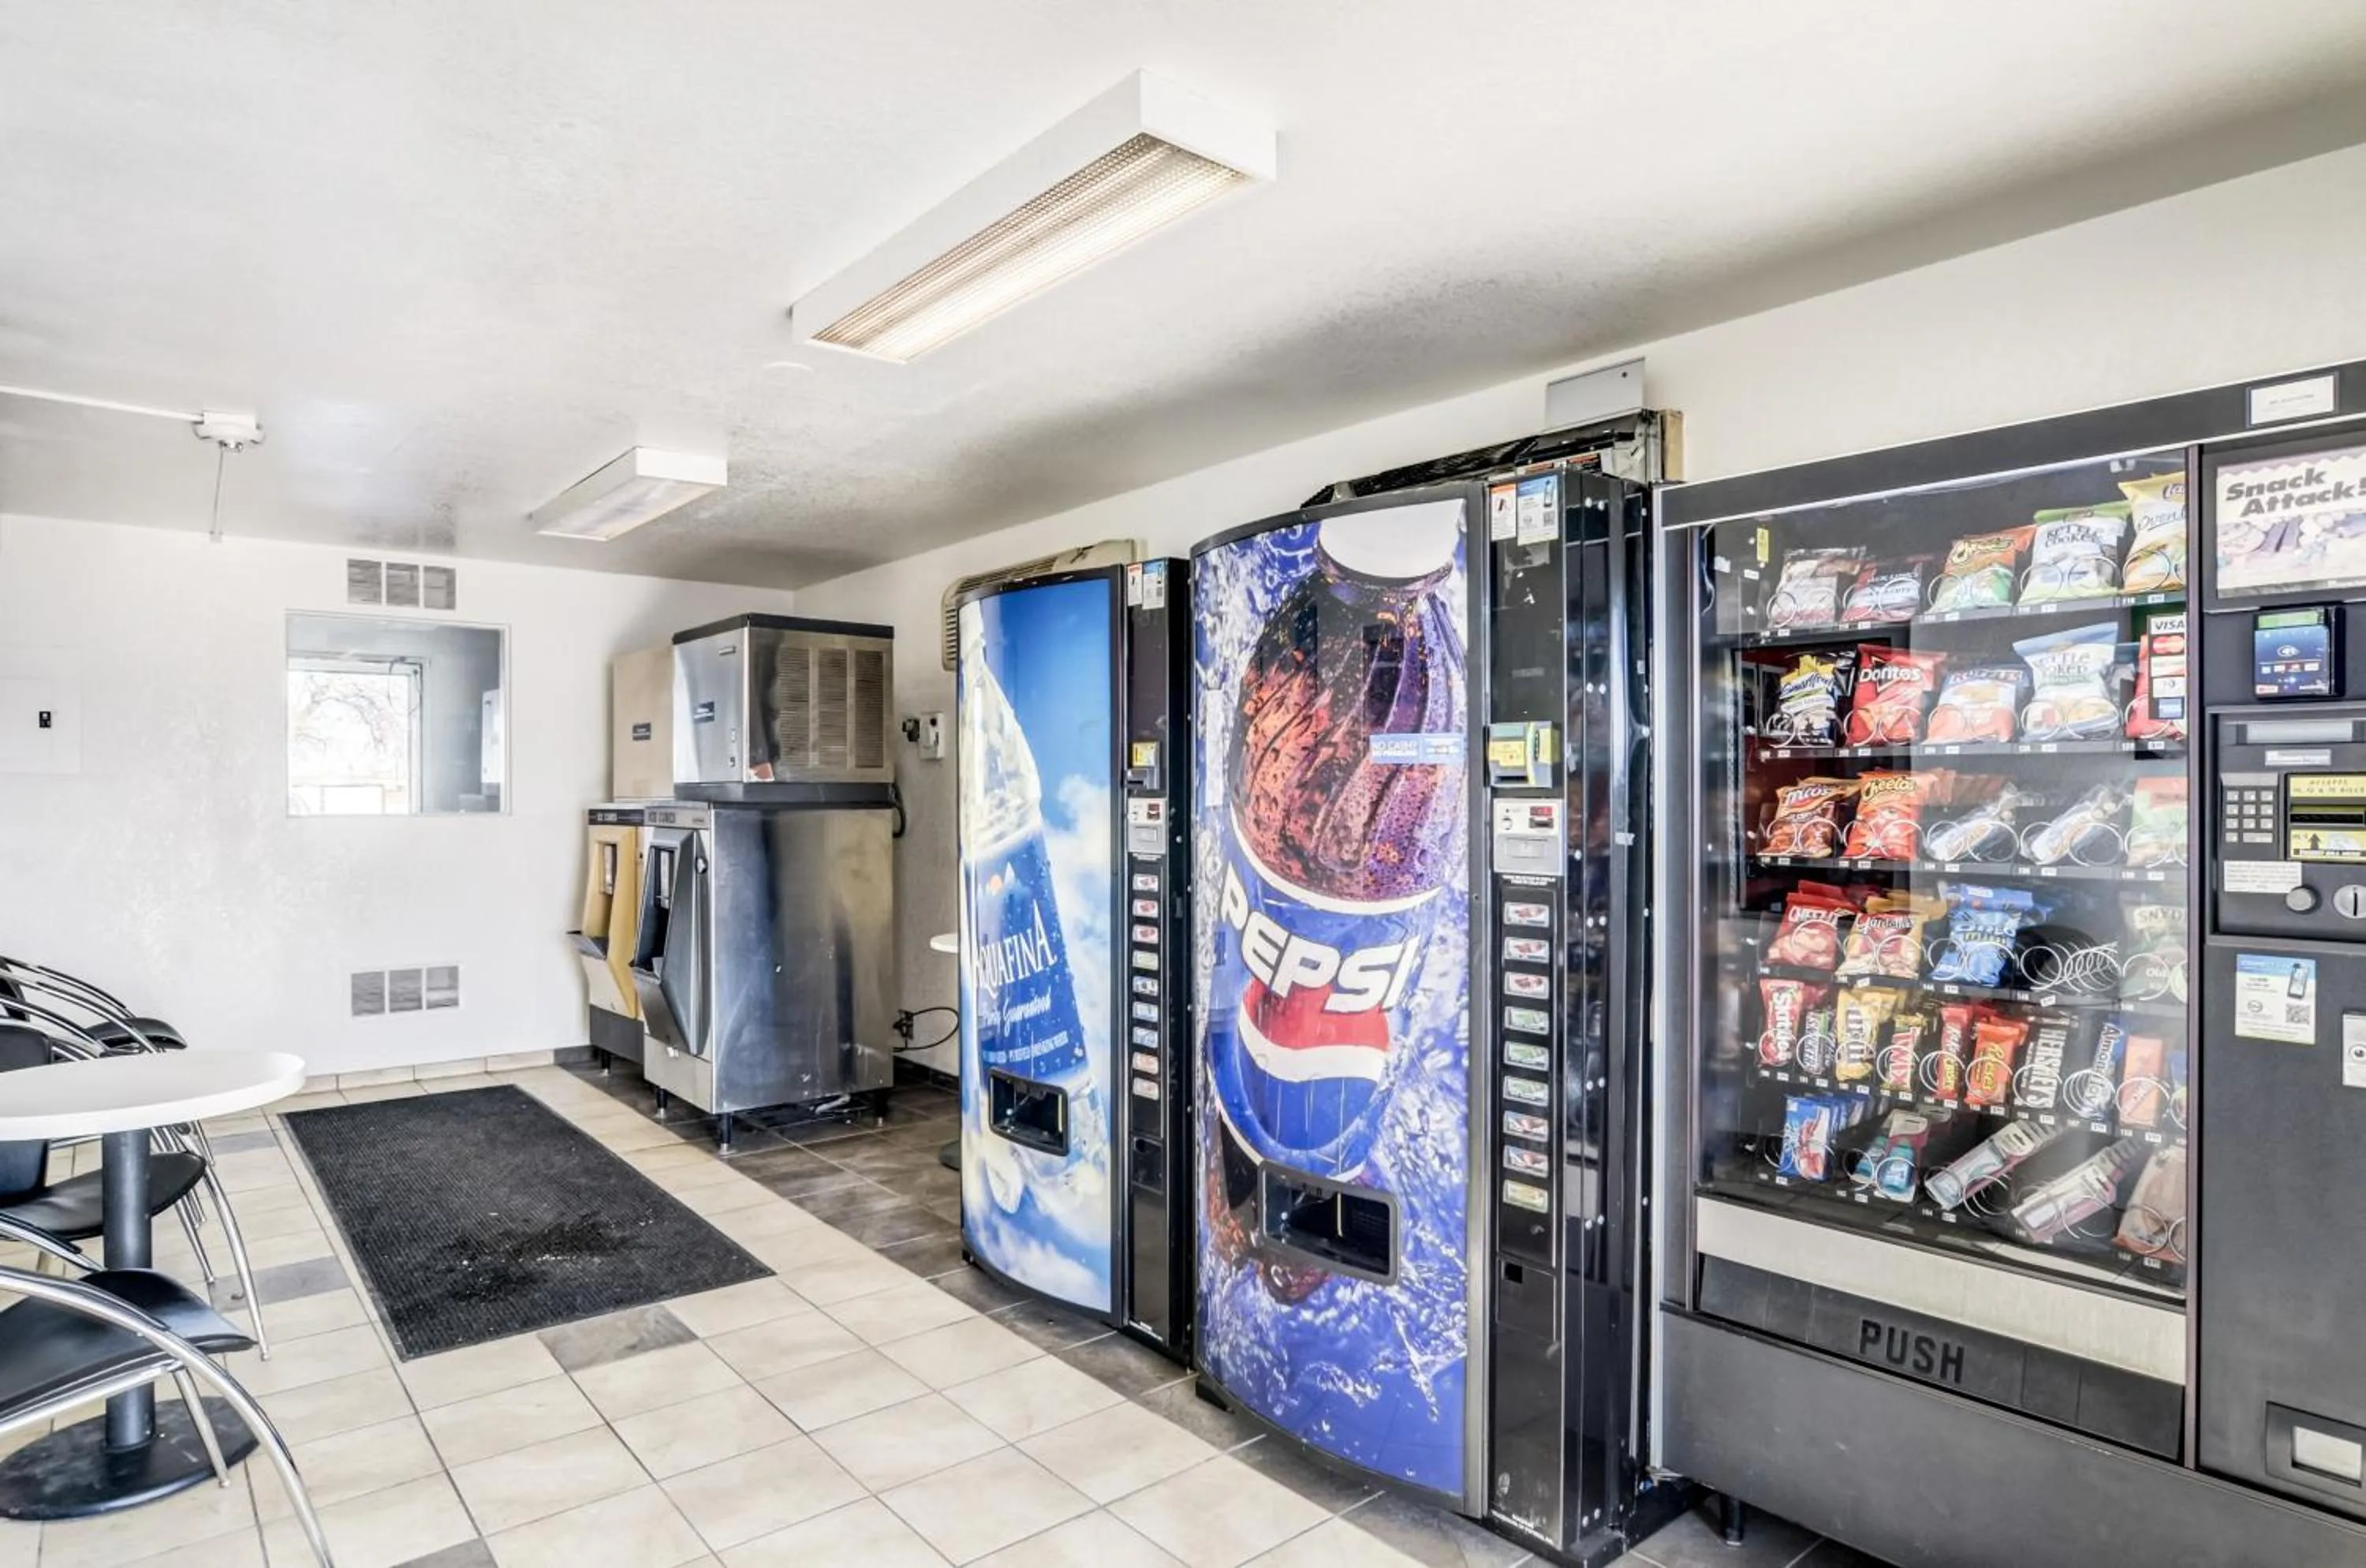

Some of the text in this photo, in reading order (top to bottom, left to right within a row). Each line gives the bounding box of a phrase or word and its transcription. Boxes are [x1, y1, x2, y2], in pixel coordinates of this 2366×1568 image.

[2226, 467, 2327, 502] Snack
[2155, 619, 2185, 630] VISA
[1859, 666, 1922, 682] Doritos
[1863, 777, 1916, 801] Cheetos
[1220, 861, 1420, 1014] PEPSI
[2025, 1028, 2067, 1108] HERSHEY'S
[1860, 1318, 1965, 1384] PUSH
